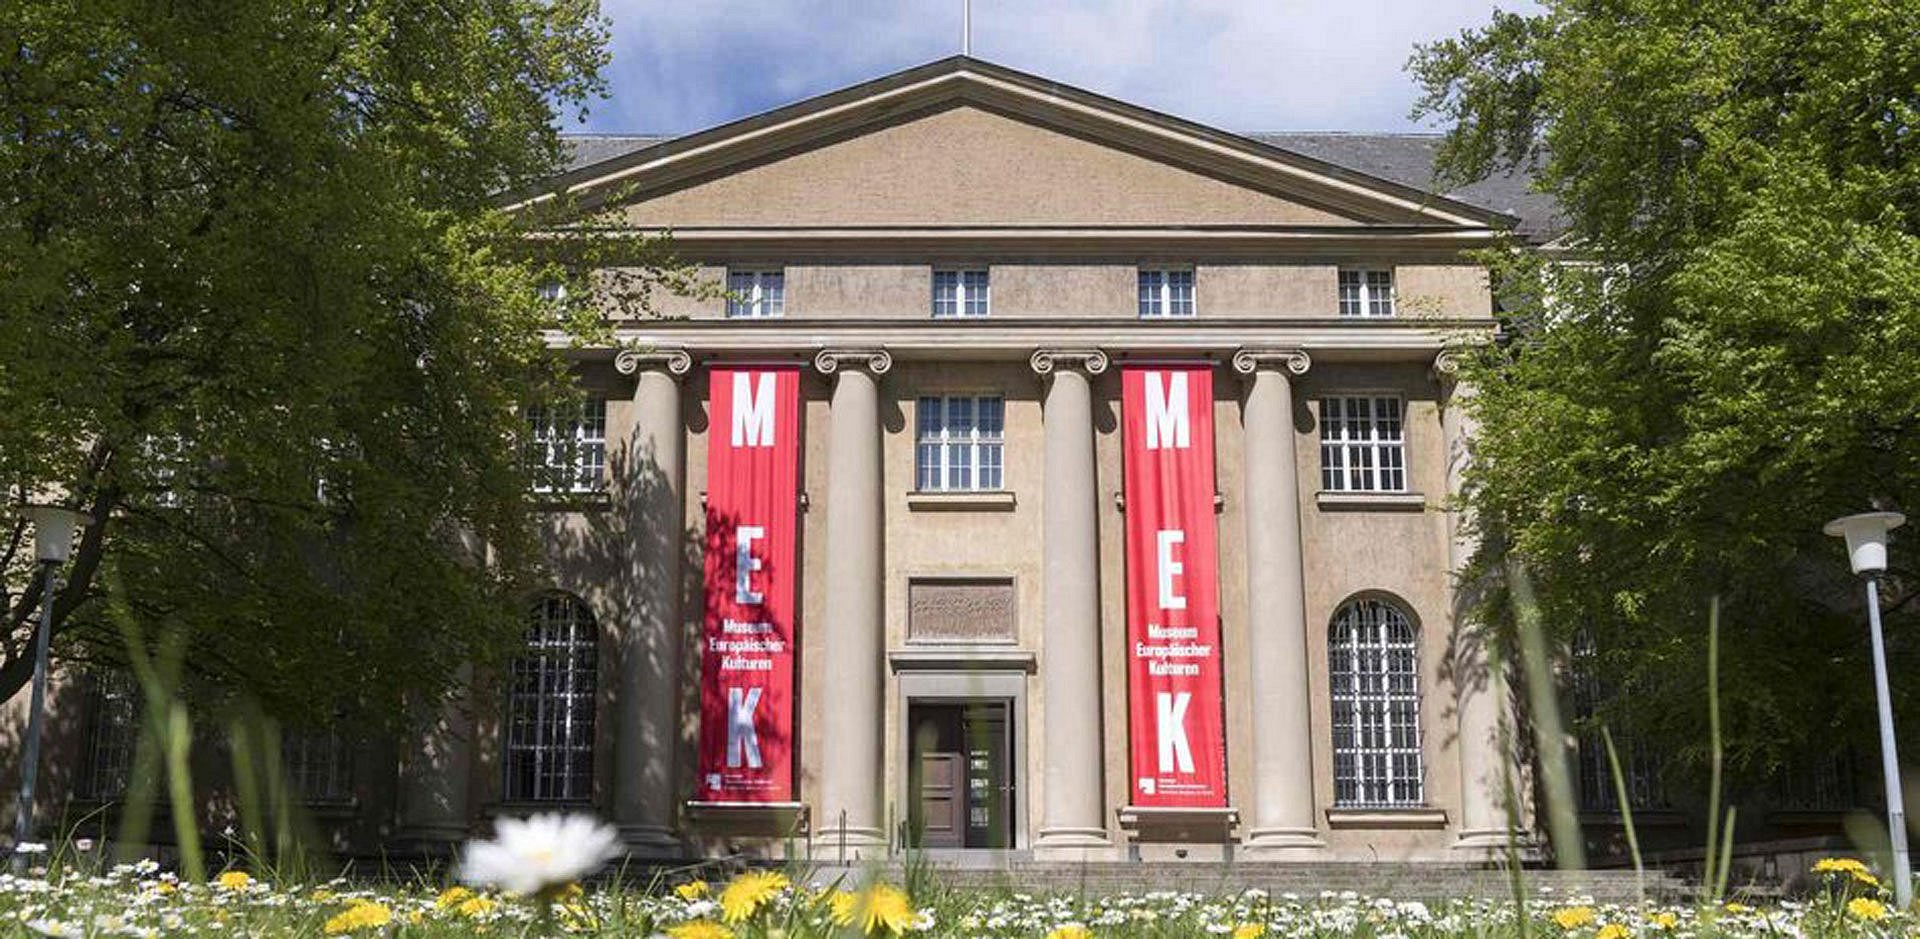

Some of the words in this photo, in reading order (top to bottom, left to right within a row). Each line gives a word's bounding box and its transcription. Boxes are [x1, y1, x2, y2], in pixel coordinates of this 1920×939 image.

[731, 371, 776, 447] M
[1145, 371, 1190, 449] M
[736, 526, 765, 604] E
[1158, 530, 1187, 610] E
[709, 636, 786, 655] Europäischer
[723, 618, 774, 634] Museum
[1148, 623, 1198, 639] Museum
[721, 655, 773, 670] Kulturen
[1136, 641, 1213, 660] Europäischer
[1149, 660, 1200, 676] Kulturen
[727, 687, 763, 768] K
[1157, 691, 1195, 773] K
